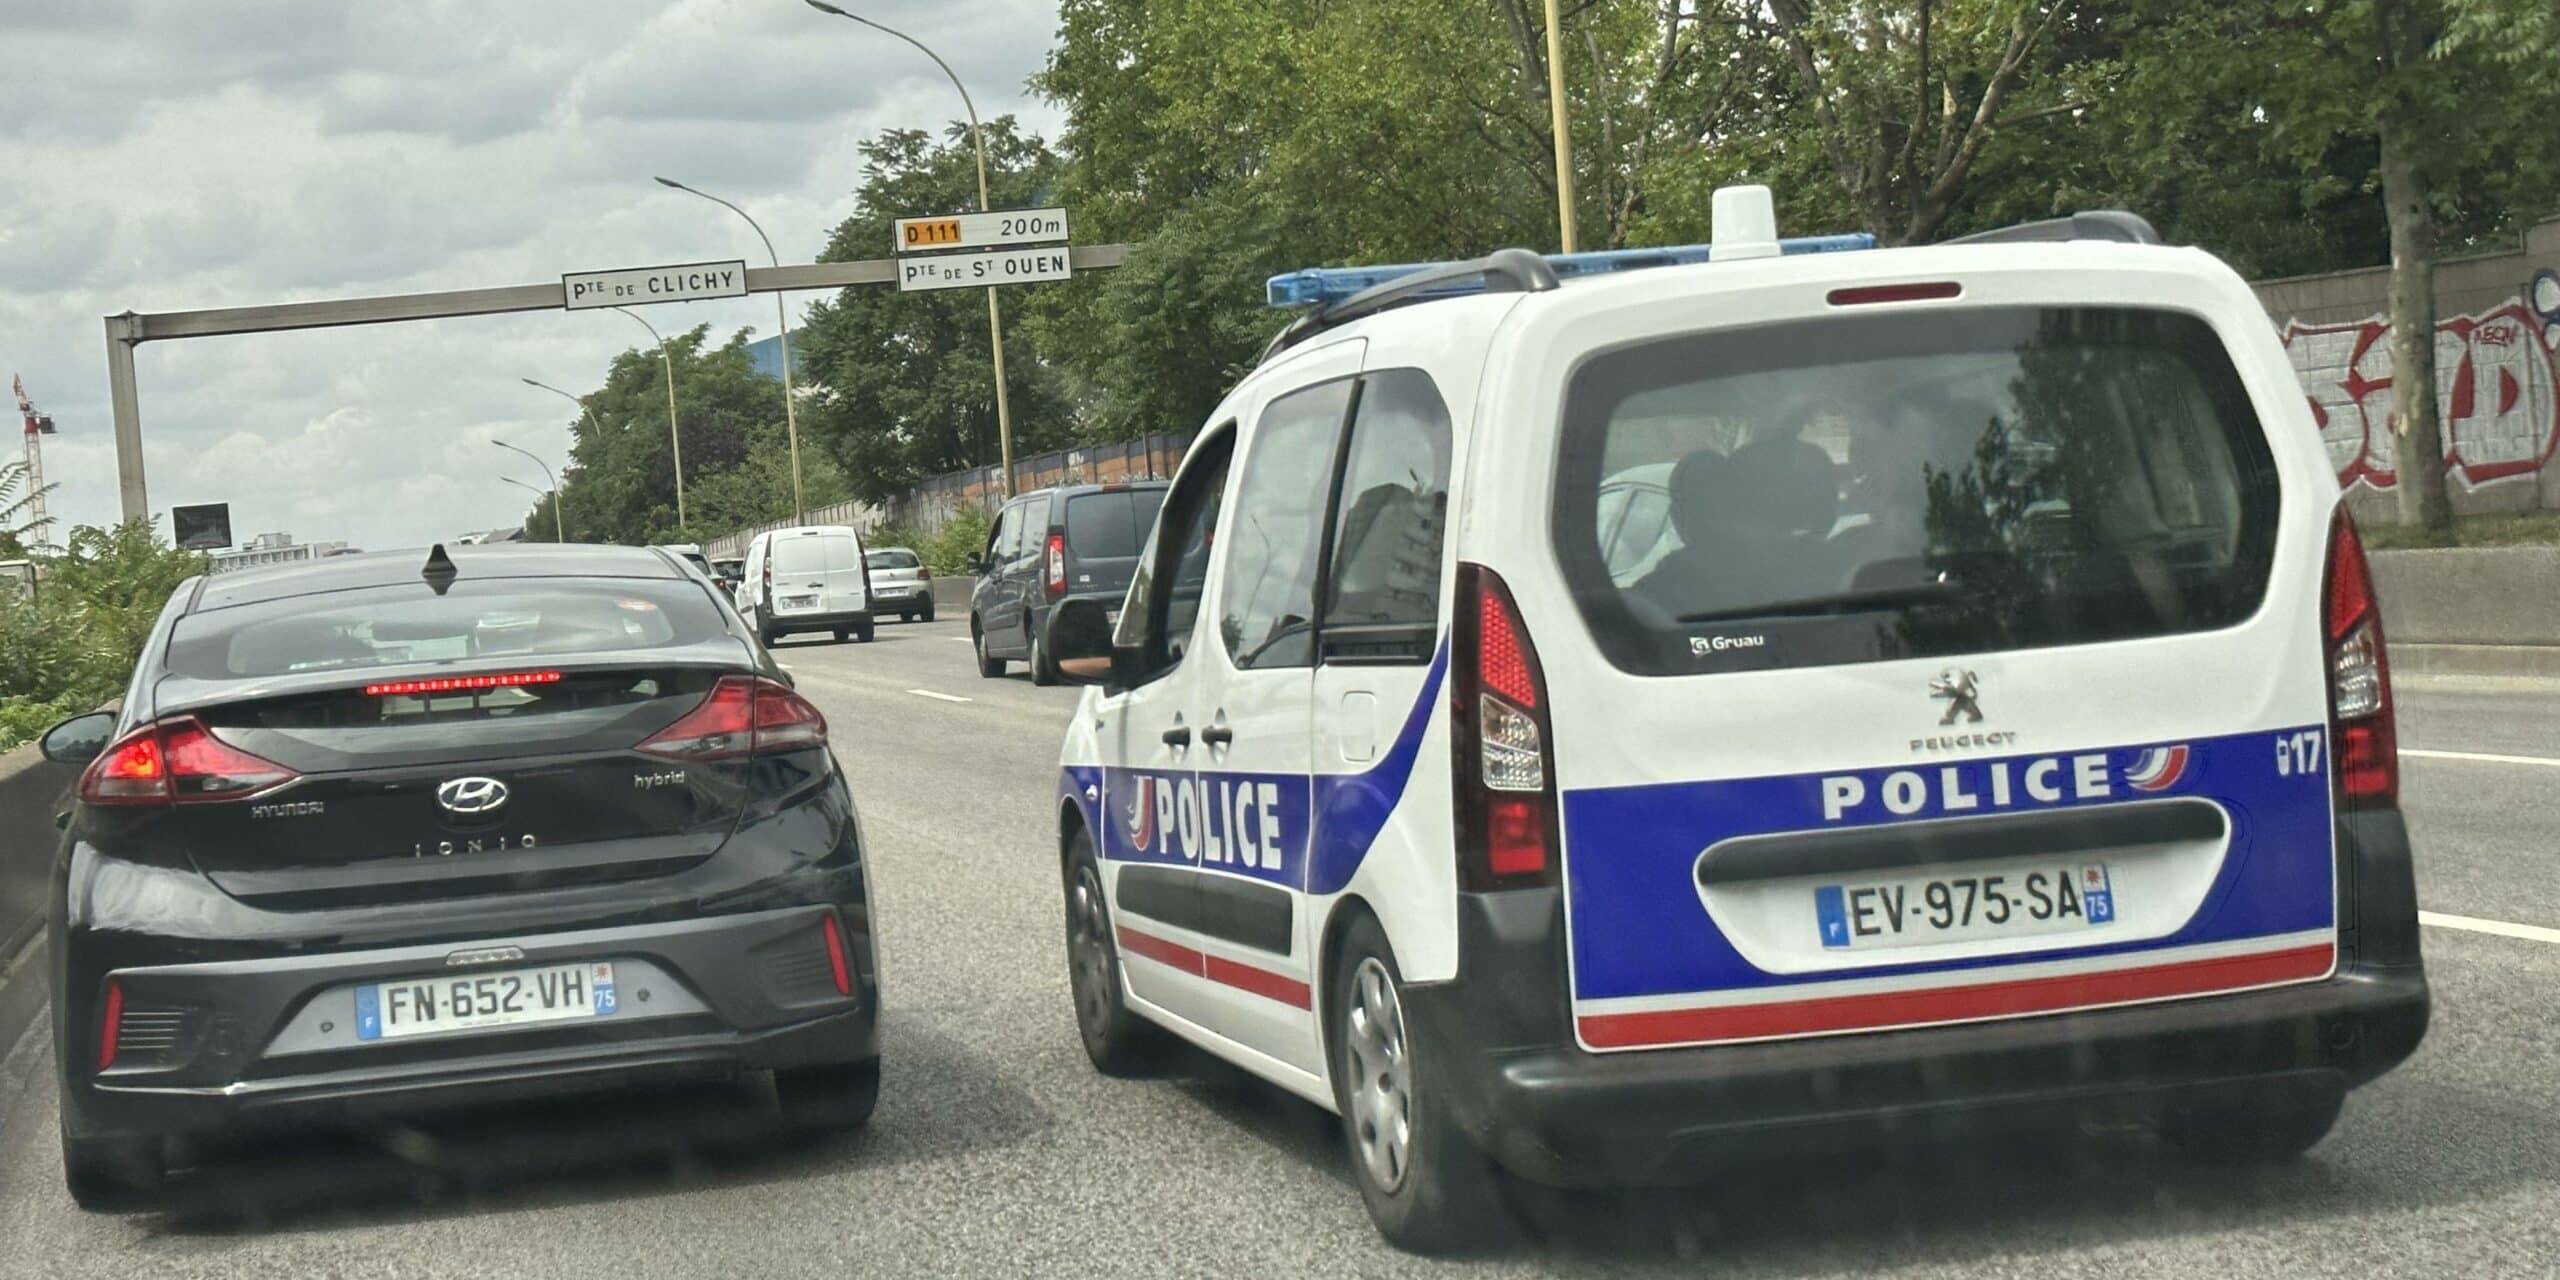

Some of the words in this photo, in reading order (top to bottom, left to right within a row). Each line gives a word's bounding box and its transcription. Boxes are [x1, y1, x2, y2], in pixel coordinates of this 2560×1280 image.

[907, 227, 918, 242] D
[926, 223, 960, 241] 111
[1001, 218, 1060, 236] 200m
[944, 269, 961, 280] DE
[1005, 256, 1063, 275] OUEN
[615, 285, 635, 296] DE
[648, 271, 732, 293] CLICHY
[1712, 636, 1764, 650] Gruau
[1910, 731, 2016, 751] PEUGEOT
[2290, 730, 2320, 774] 17
[633, 770, 685, 790] hybrid
[1822, 753, 2111, 821] POLICE
[251, 801, 325, 818] HYUNDAI
[1155, 777, 1282, 870] POLICE
[1829, 922, 1840, 937] F
[1850, 870, 2083, 937] EV-975-SA
[2087, 896, 2109, 917] 75
[364, 1017, 373, 1029] F
[387, 969, 585, 1025] FN-652-VH
[594, 989, 616, 1008] 75
